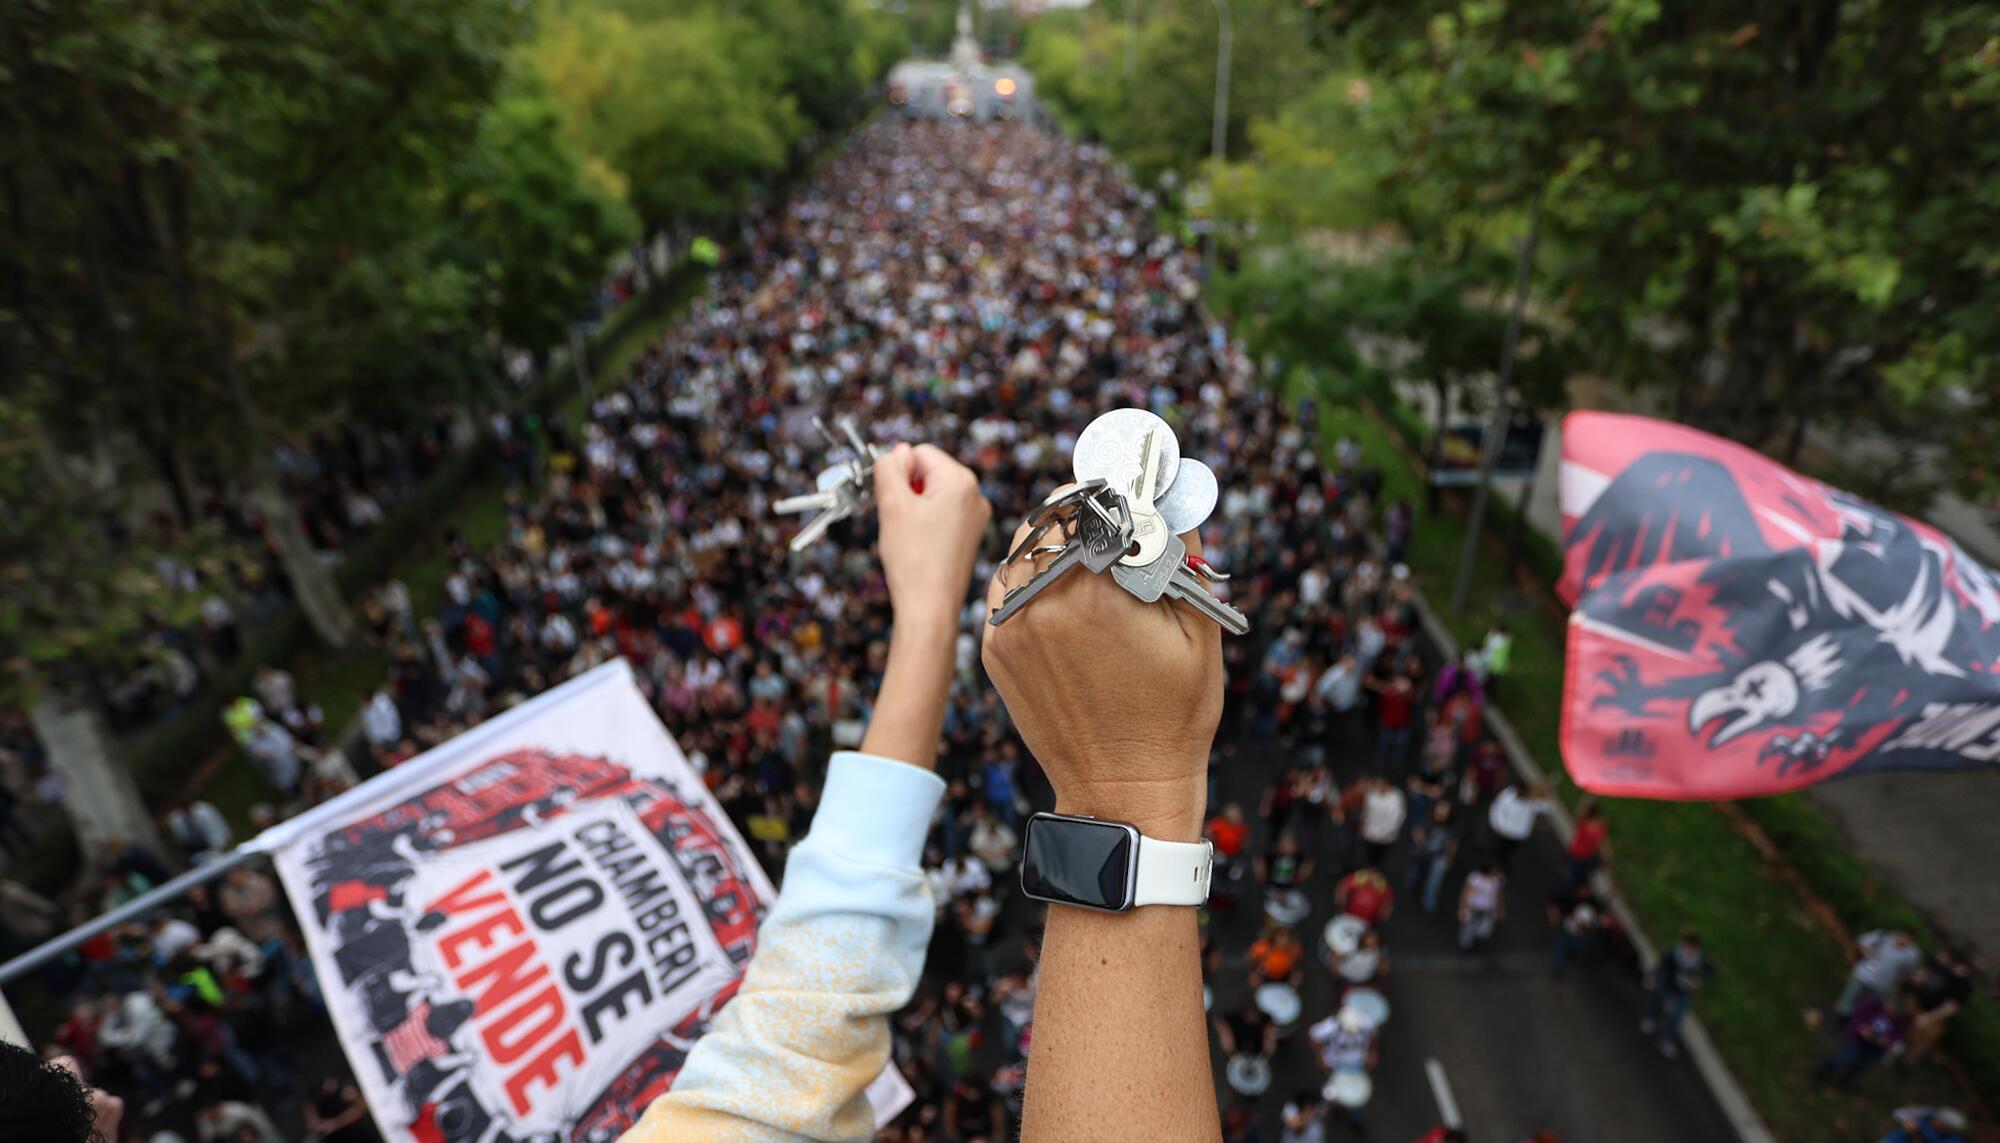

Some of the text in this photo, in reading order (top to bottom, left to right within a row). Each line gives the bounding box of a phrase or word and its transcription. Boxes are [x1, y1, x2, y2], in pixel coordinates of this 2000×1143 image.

[425, 868, 586, 1117] VENDE
[499, 840, 654, 1045] NO SE
